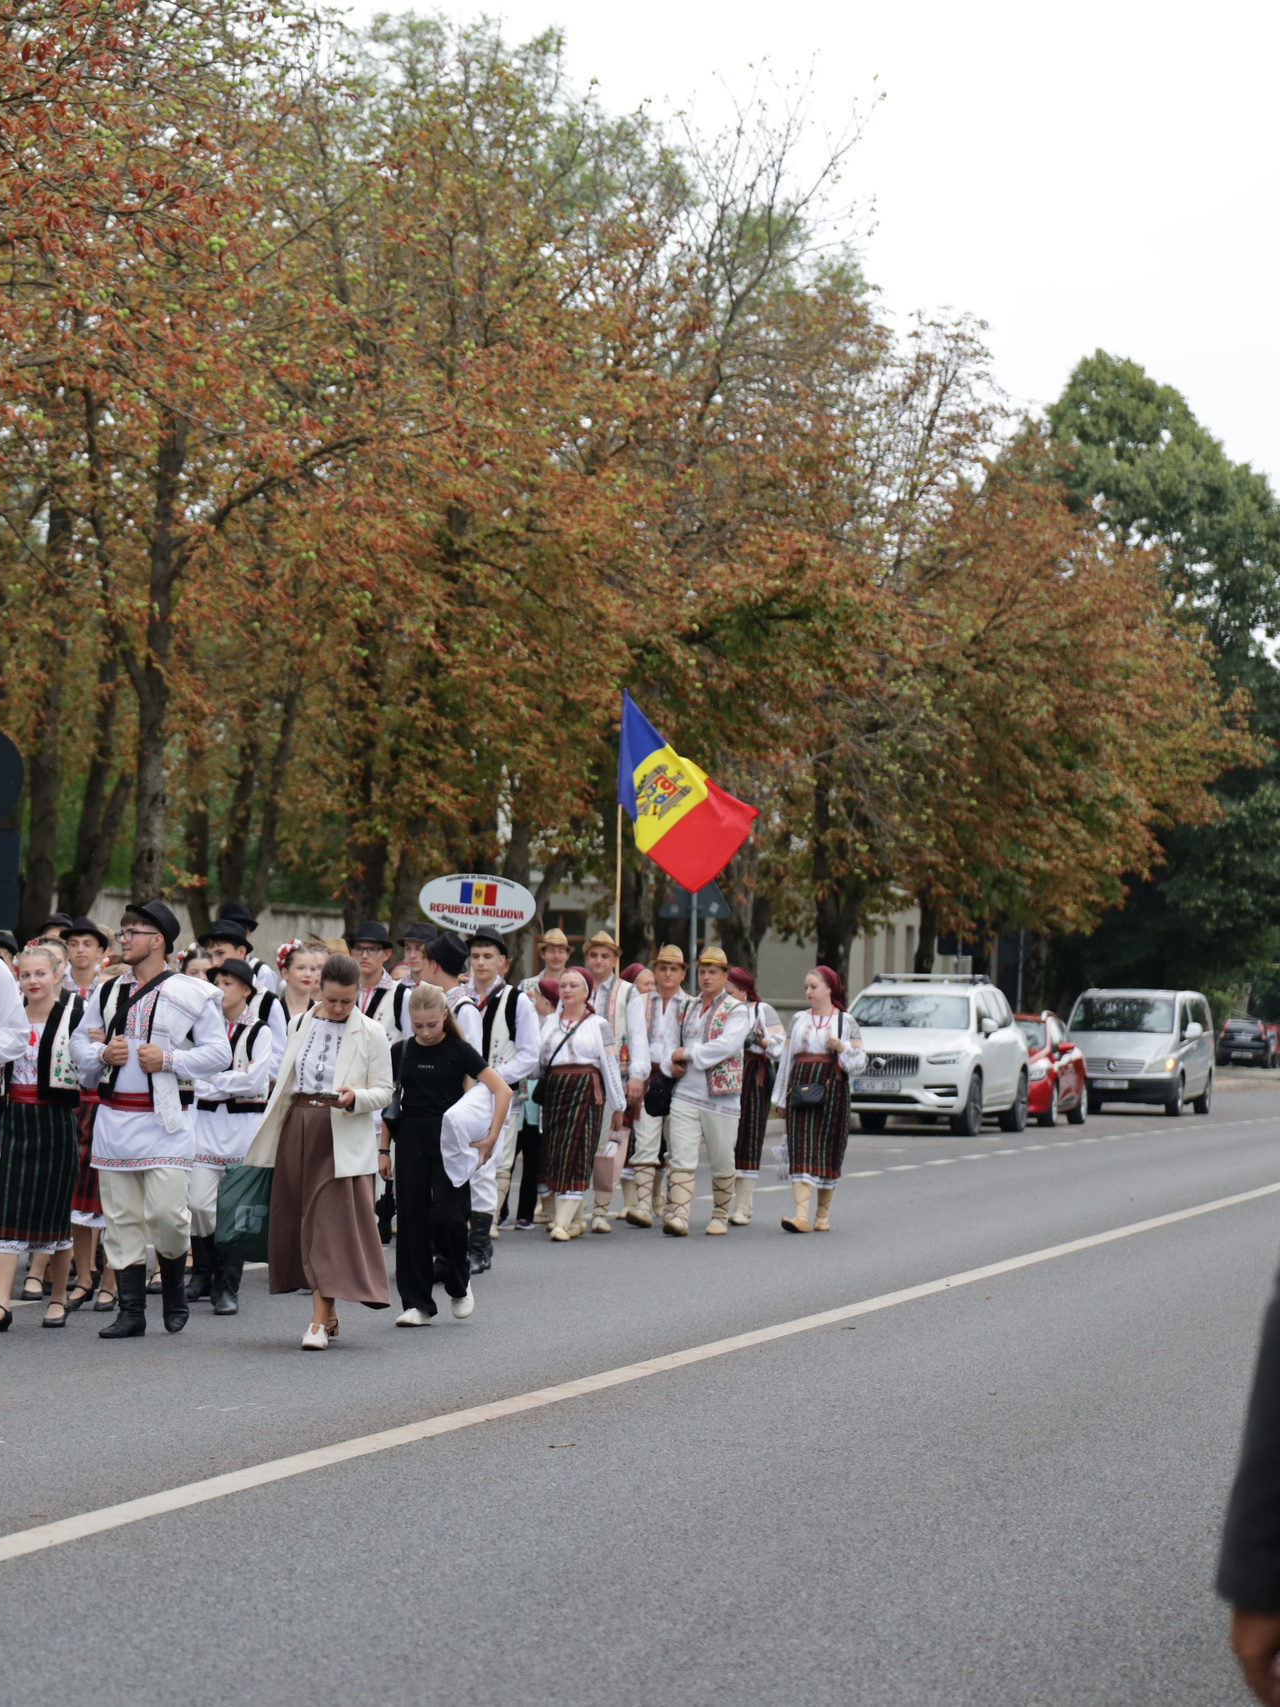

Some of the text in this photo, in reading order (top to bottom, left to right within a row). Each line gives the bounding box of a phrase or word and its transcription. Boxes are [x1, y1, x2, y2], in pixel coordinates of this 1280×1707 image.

[429, 902, 524, 920] REPUBLICA MOLDOVA
[459, 921, 468, 930] DE
[469, 922, 477, 931] LA
[881, 1080, 896, 1089] 918
